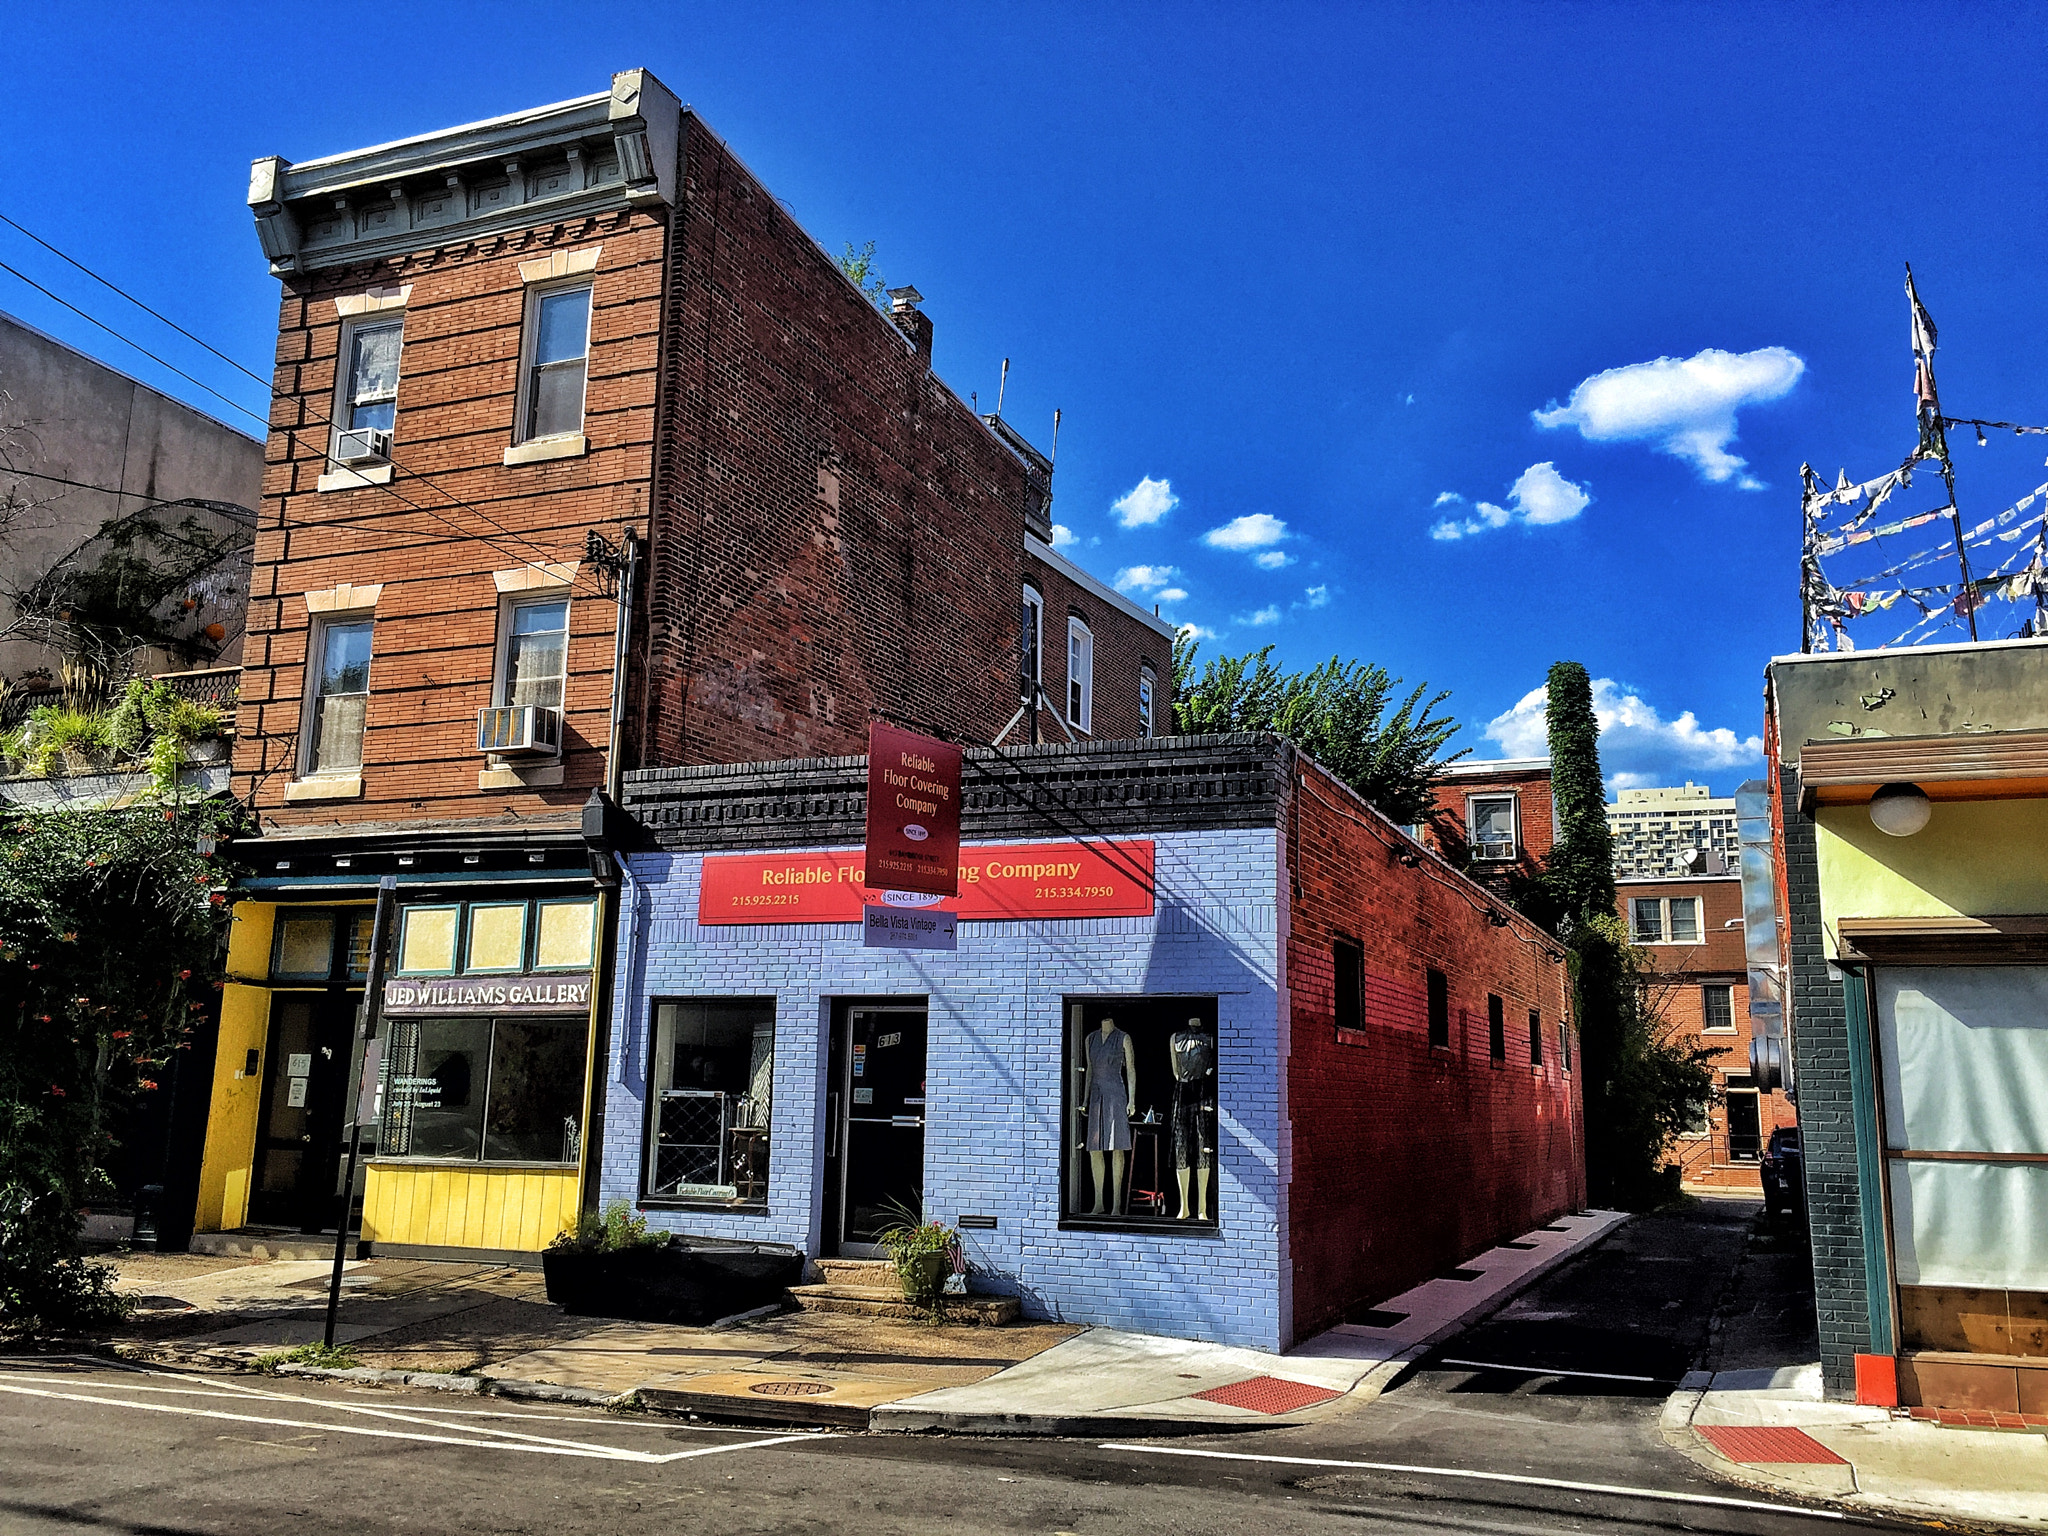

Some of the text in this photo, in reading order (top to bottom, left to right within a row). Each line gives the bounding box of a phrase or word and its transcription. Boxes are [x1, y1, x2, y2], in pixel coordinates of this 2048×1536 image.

[901, 752, 935, 773] Reliable
[884, 768, 949, 800] Floor Covering
[896, 793, 937, 817] Company
[906, 828, 917, 836] SINCE
[762, 865, 865, 885] Reliable Flo
[986, 861, 1081, 881] Company
[732, 886, 1113, 906] 215.925.2215 215.334.7950
[886, 893, 915, 902] SINCE
[869, 913, 937, 934] Bella Vista Vintage
[387, 983, 590, 1006] JED WILLIAMS GALLERY
[880, 1033, 900, 1047] 613
